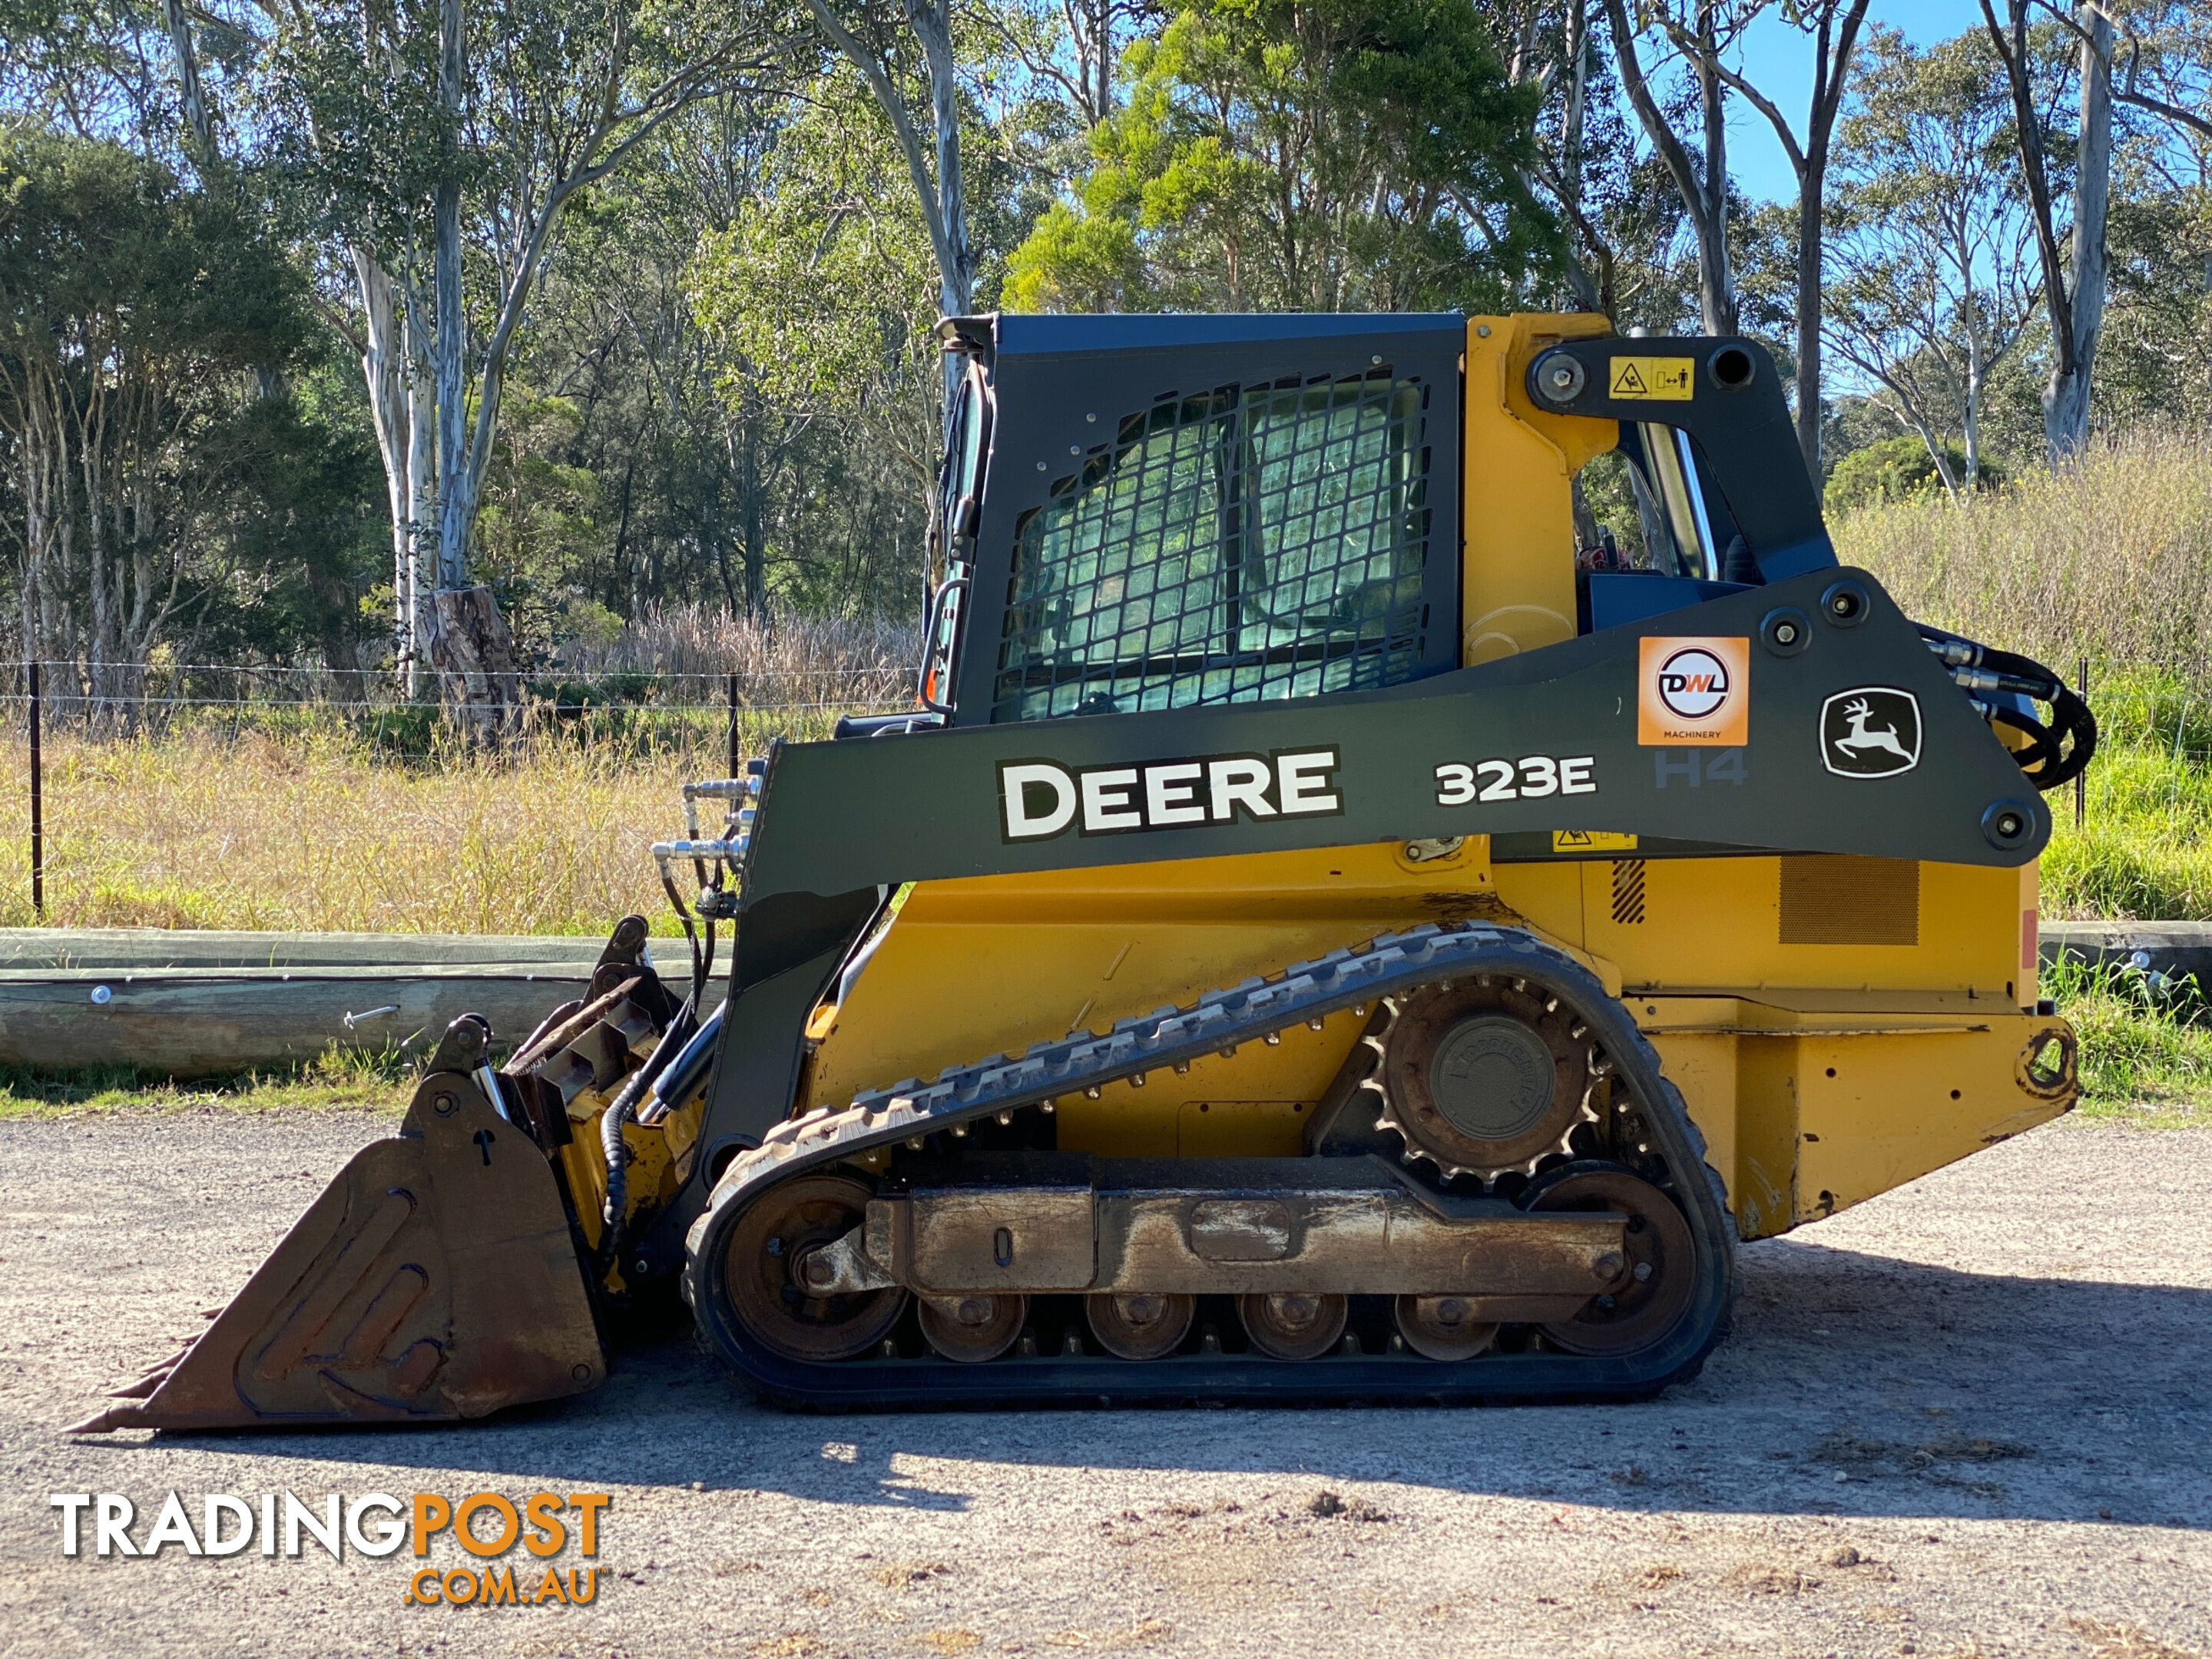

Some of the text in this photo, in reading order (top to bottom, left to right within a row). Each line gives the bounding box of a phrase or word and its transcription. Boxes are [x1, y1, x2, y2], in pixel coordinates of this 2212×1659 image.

[1659, 674, 1727, 693] DWL
[1664, 730, 1721, 739] MACHINERY
[1435, 757, 1596, 804] 323E
[1654, 747, 1750, 789] H4
[1002, 751, 1338, 837] DEERE
